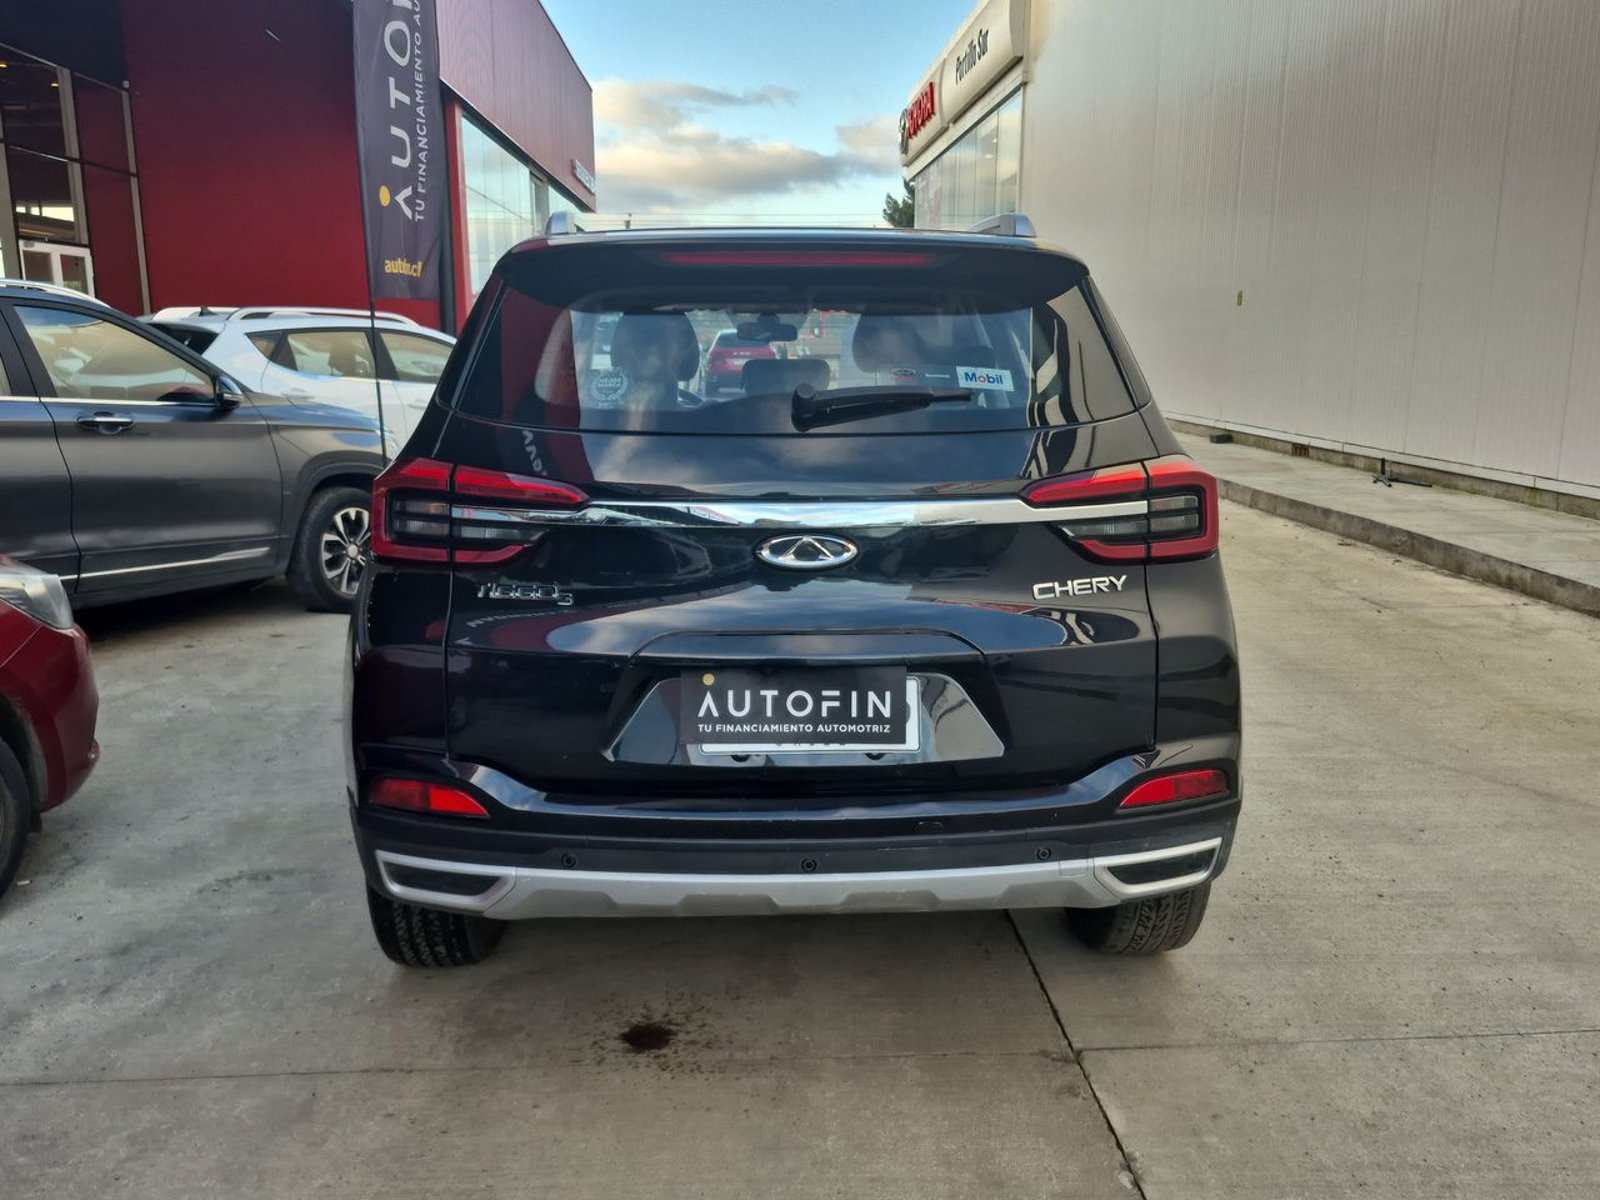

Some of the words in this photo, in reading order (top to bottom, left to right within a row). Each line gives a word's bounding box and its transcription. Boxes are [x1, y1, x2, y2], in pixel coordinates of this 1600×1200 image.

[413, 32, 428, 194] FINANCIAMIENTO
[415, 199, 425, 222] TU
[964, 371, 1004, 385] Mobil
[1033, 575, 1127, 600] CHERY
[698, 689, 892, 718] AUTOFIN
[698, 723, 713, 734] TU
[715, 723, 814, 734] FINANCIAMIENTO
[816, 723, 891, 734] AUTOMOTRIZ
